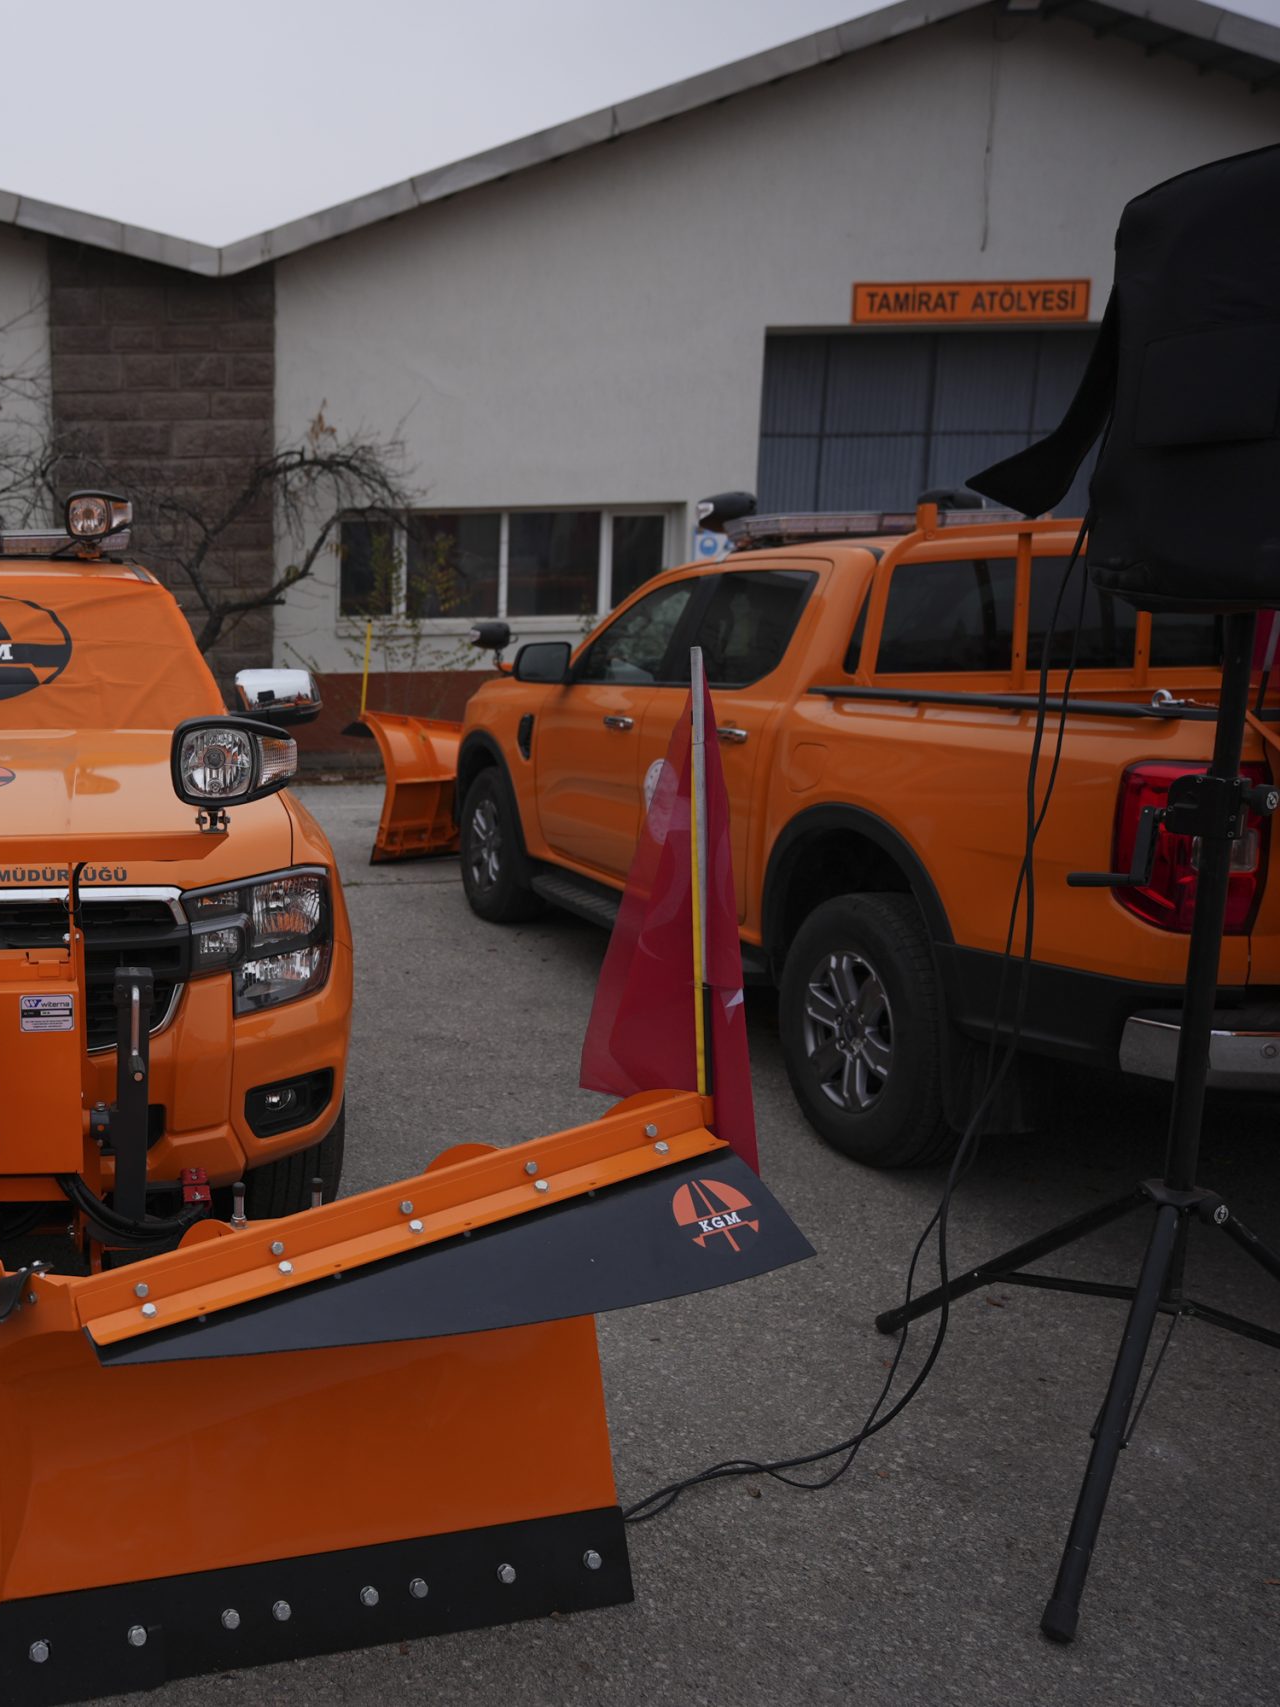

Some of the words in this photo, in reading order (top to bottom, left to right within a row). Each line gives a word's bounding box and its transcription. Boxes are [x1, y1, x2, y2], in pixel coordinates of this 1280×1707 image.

[865, 285, 960, 313] TAMİRAT
[971, 283, 1078, 313] ATÖLYESİ
[698, 1211, 742, 1233] KGM
